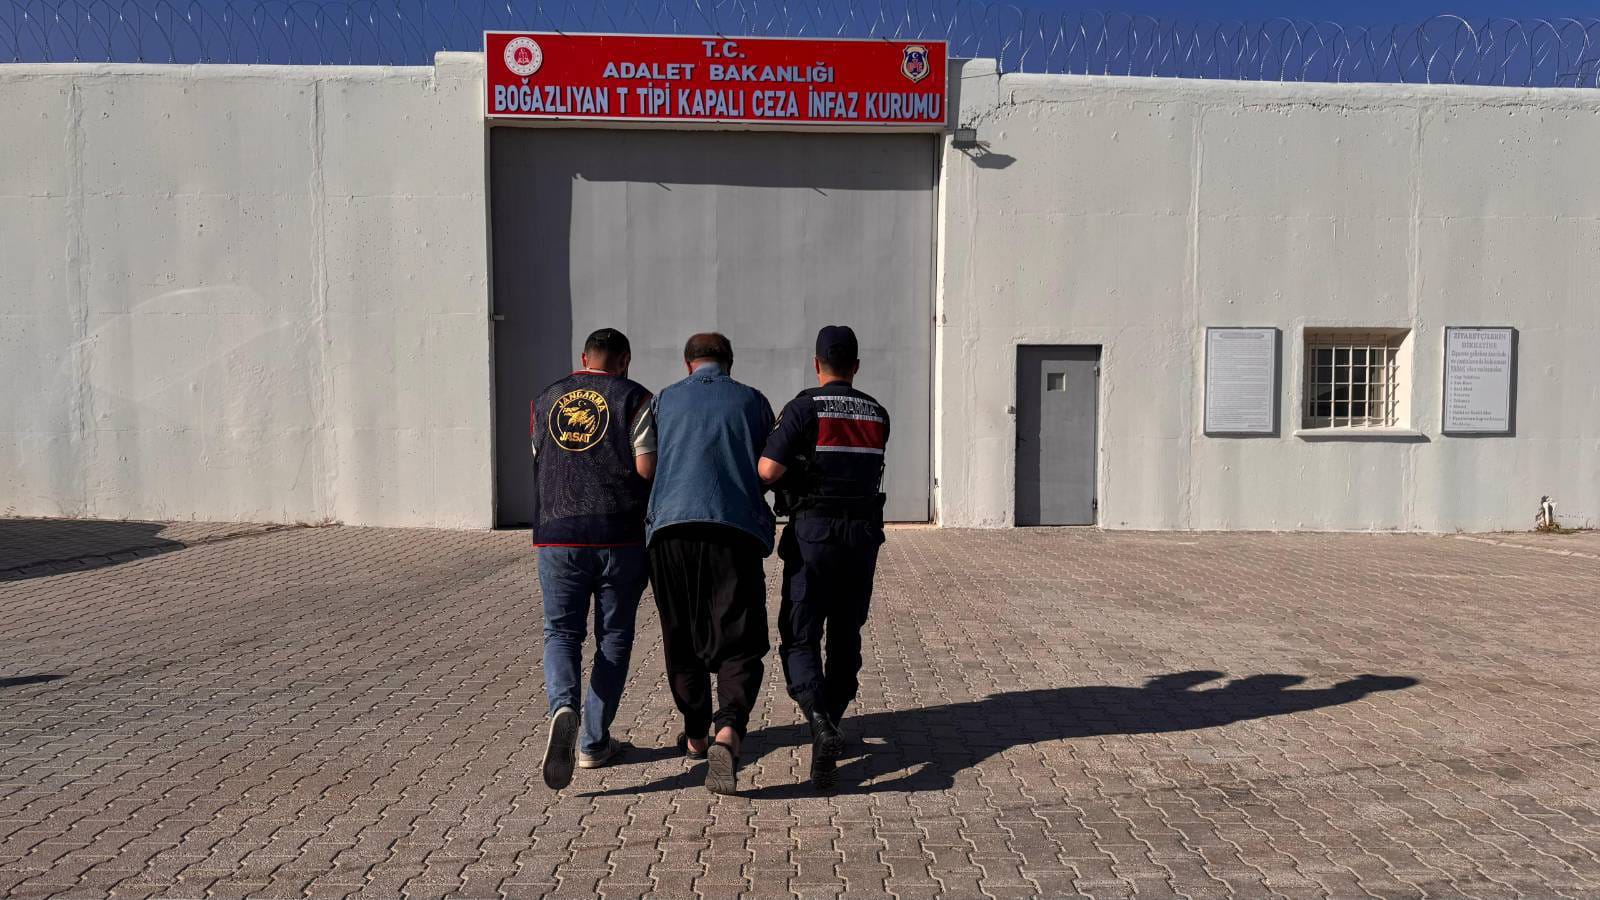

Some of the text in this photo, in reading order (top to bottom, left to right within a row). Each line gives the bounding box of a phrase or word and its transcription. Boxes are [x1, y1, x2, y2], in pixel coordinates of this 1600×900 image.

[702, 41, 745, 57] T.C.
[603, 61, 834, 83] ADALET BAKANLIĞI
[495, 78, 940, 119] BOĞAZLIYAN T TİPİ KAPALI CEZA İNFAZ KURUMU
[559, 391, 606, 412] JANDARMA
[823, 400, 877, 417] JANDARMA
[560, 431, 592, 443] JASAT
